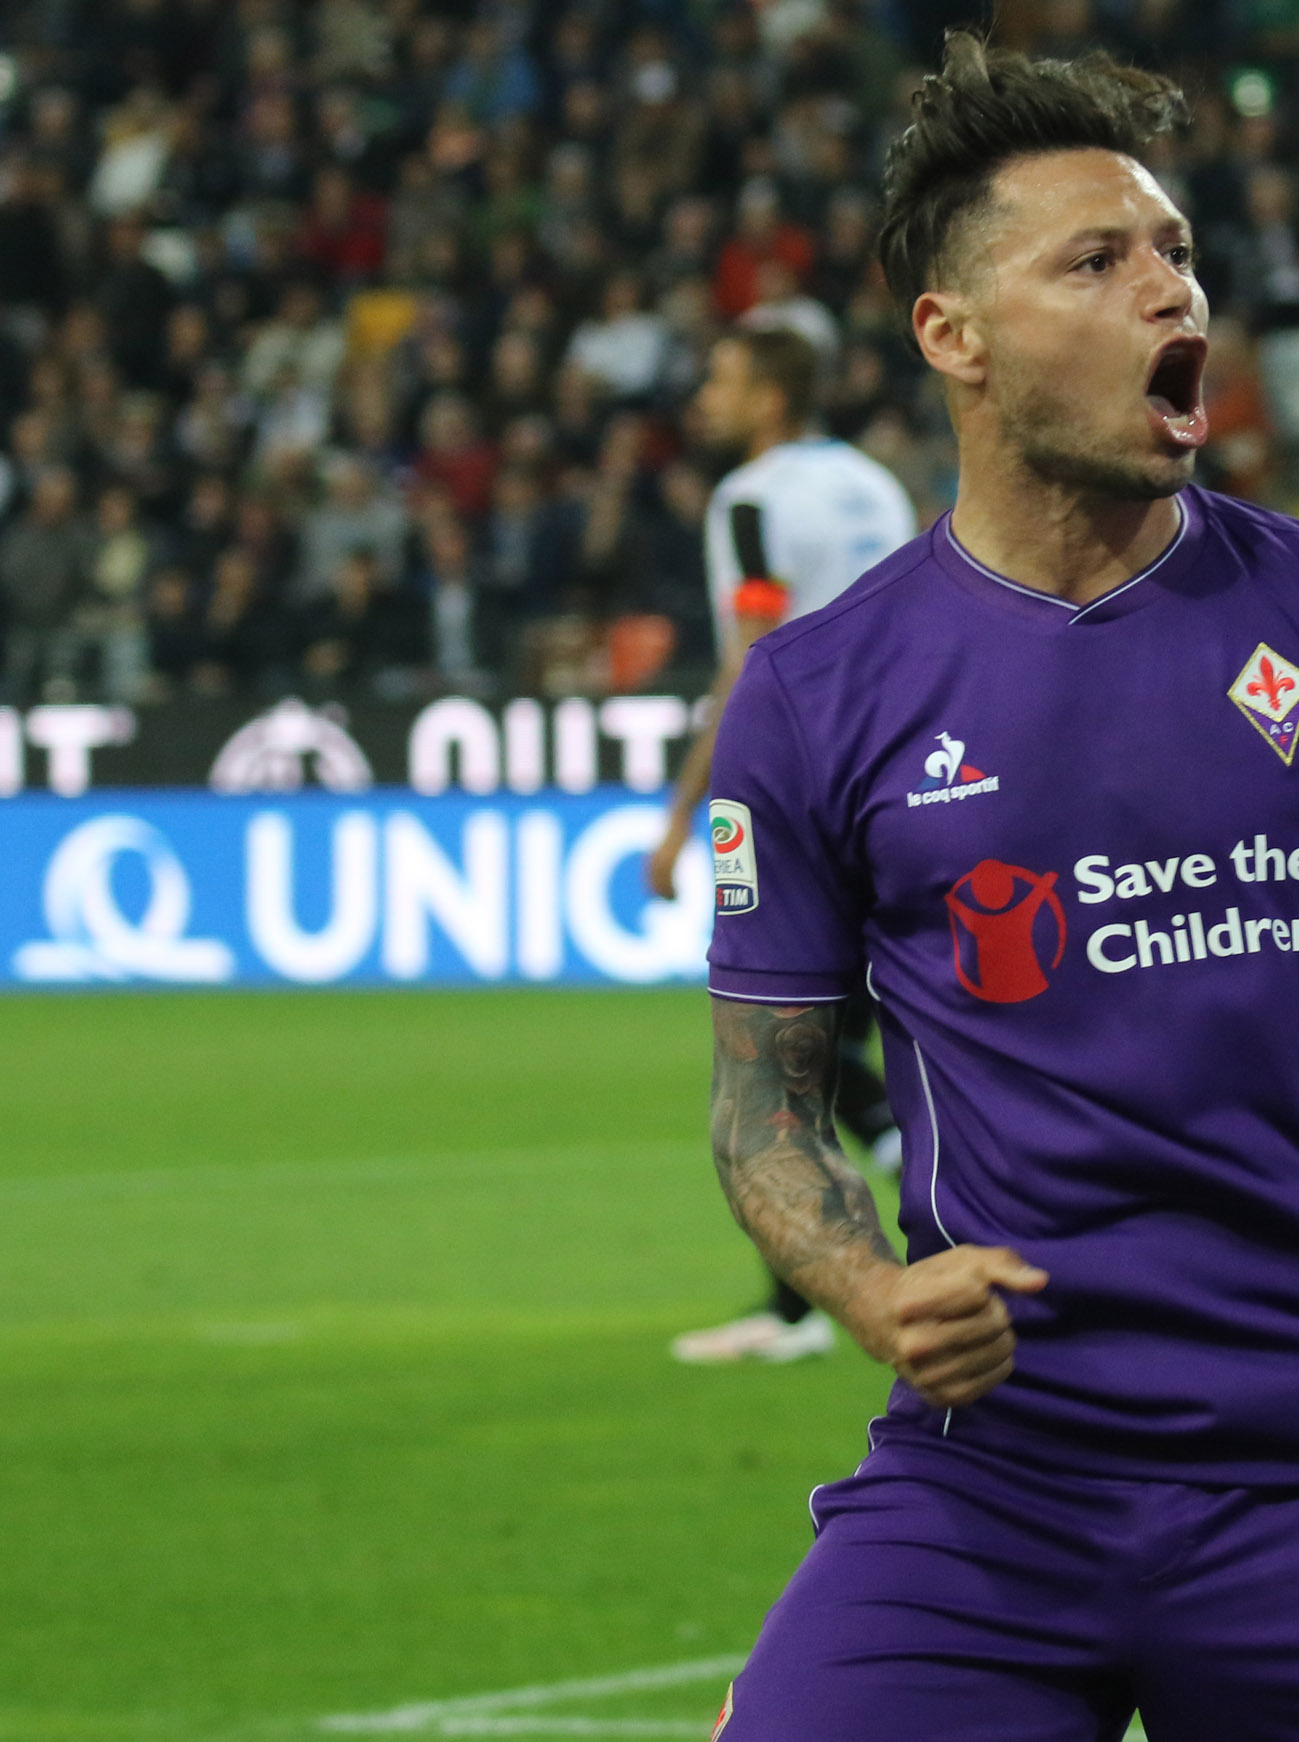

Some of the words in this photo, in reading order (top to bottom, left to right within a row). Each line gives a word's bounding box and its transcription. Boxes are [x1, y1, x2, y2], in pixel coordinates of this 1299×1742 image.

[907, 791, 922, 808] le
[922, 787, 951, 804] coq
[951, 776, 999, 800] sportif
[1073, 852, 1218, 905] Save
[723, 888, 749, 906] TIM
